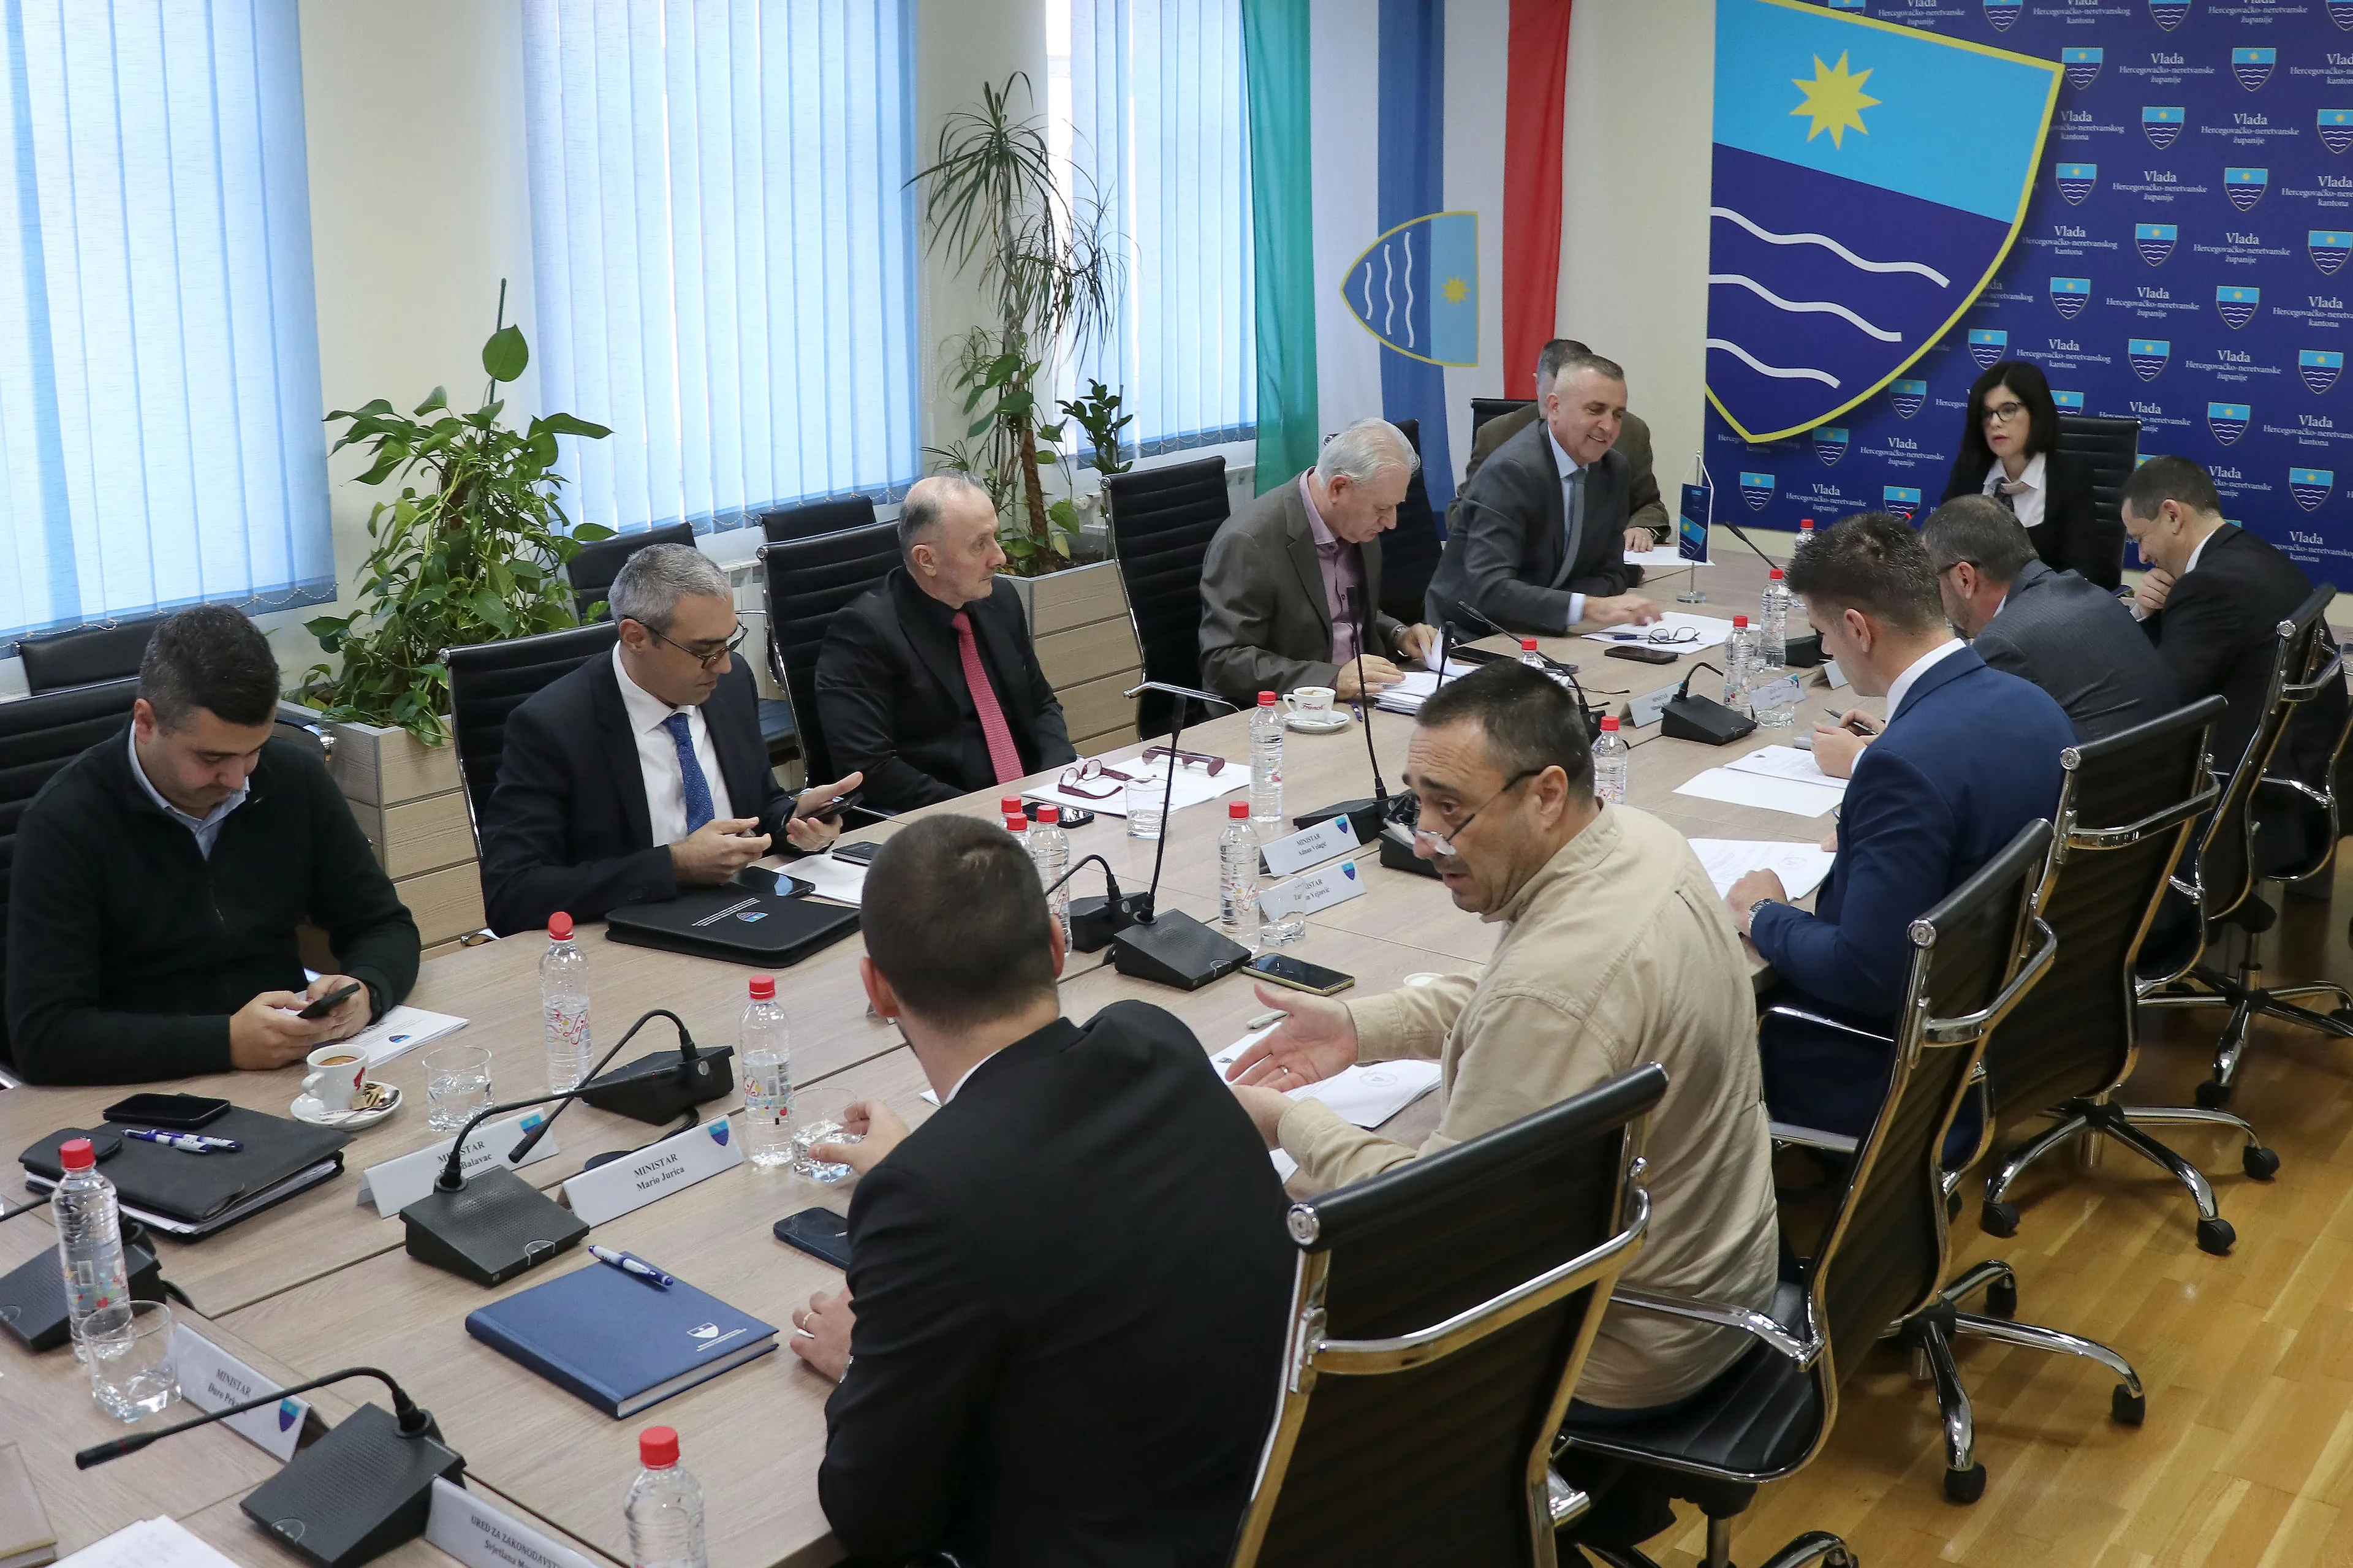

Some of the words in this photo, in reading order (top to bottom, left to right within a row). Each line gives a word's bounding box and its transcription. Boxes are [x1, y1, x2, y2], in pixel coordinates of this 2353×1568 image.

[2151, 53, 2184, 64] Vlada
[2061, 110, 2093, 122] Vlada
[2234, 113, 2268, 125] Vlada
[2144, 170, 2177, 183] Vlada
[2317, 175, 2352, 187] Vlada
[2054, 225, 2086, 237] Vlada
[2226, 232, 2259, 244] Vlada
[2137, 287, 2169, 300] Vlada
[2309, 296, 2343, 309] Vlada
[2048, 338, 2080, 351] Vlada
[2218, 350, 2251, 363] Vlada
[2129, 401, 2162, 415] Vlada
[2299, 414, 2333, 428] Vlada
[1888, 437, 1918, 450] Vlada
[2208, 466, 2242, 479] Vlada
[1812, 483, 1840, 496] Vlada
[2289, 531, 2324, 545] Vlada
[1297, 833, 1321, 846] MINISTAR
[634, 1153, 678, 1177] MINISTAR
[636, 1176, 660, 1192] Mario
[661, 1166, 685, 1181] Jurica
[216, 1369, 251, 1398] MINISTAR
[491, 1527, 501, 1539] ZA
